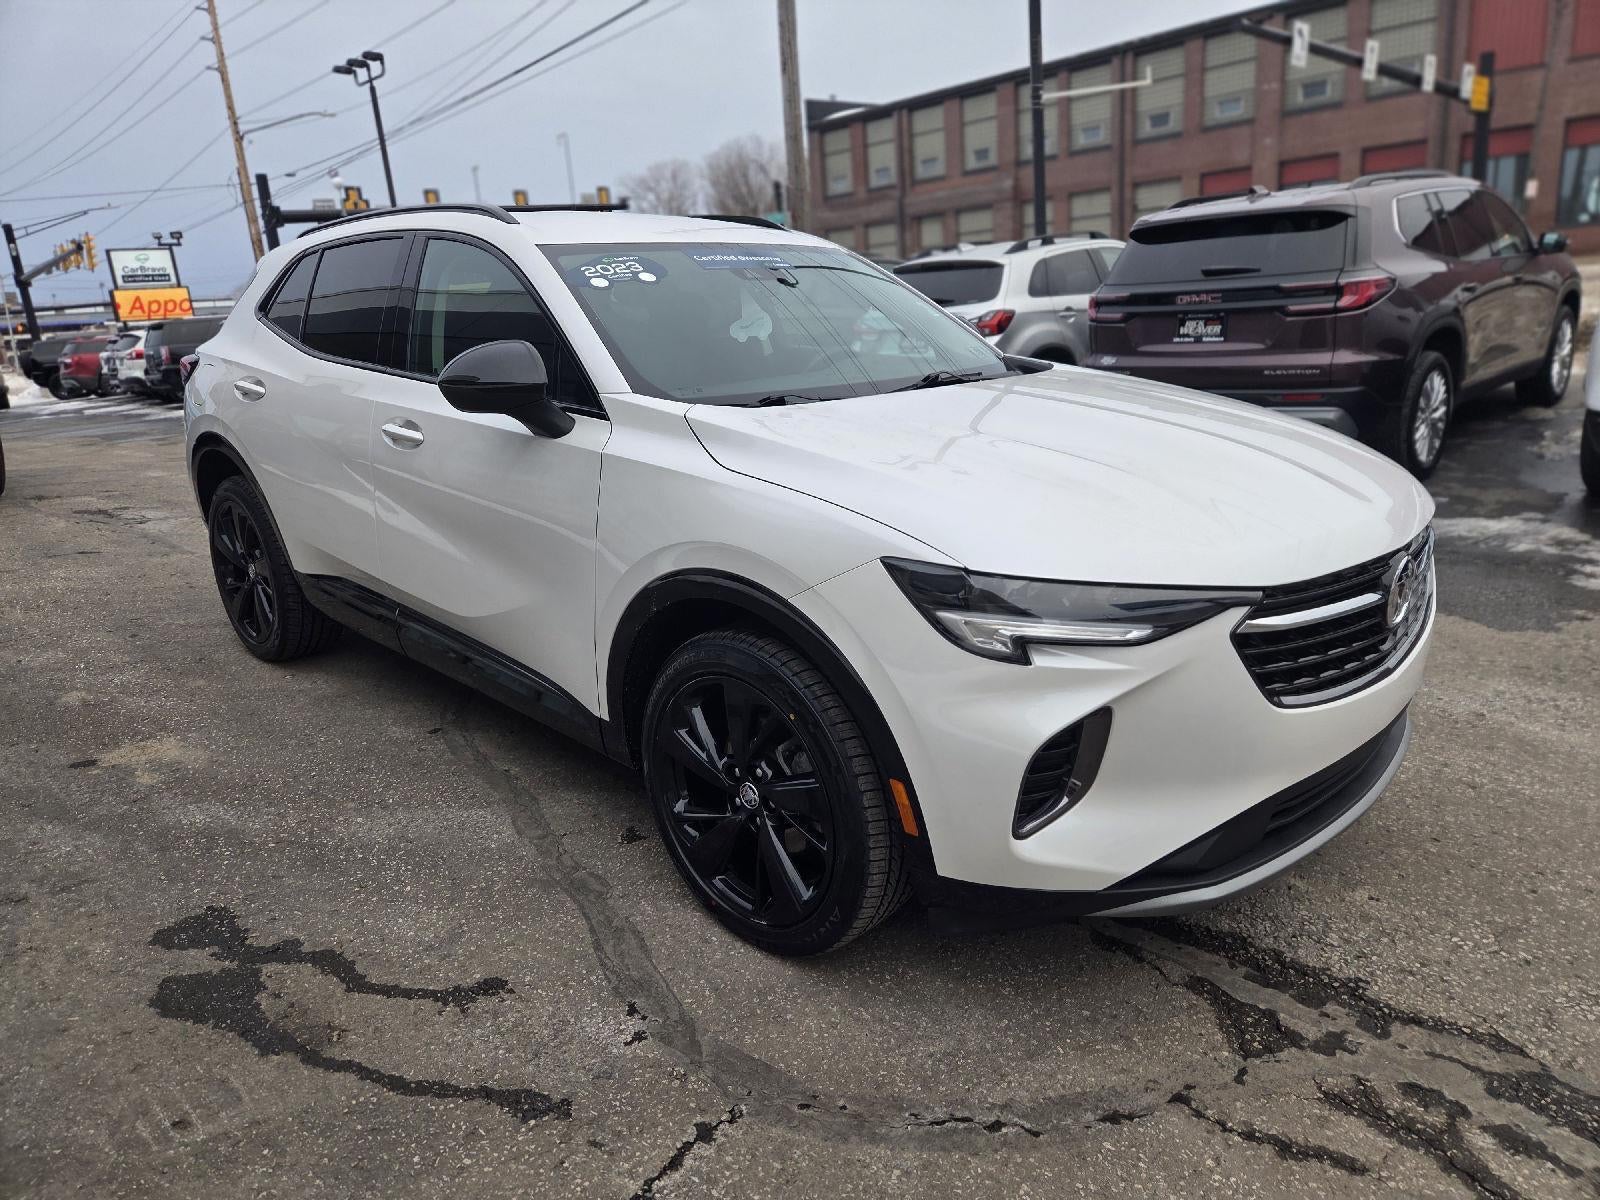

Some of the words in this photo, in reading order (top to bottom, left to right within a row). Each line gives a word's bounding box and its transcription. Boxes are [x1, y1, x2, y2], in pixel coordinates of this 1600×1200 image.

[122, 265, 167, 274] CarBravo
[580, 261, 644, 277] 2023
[1176, 293, 1222, 304] GMC
